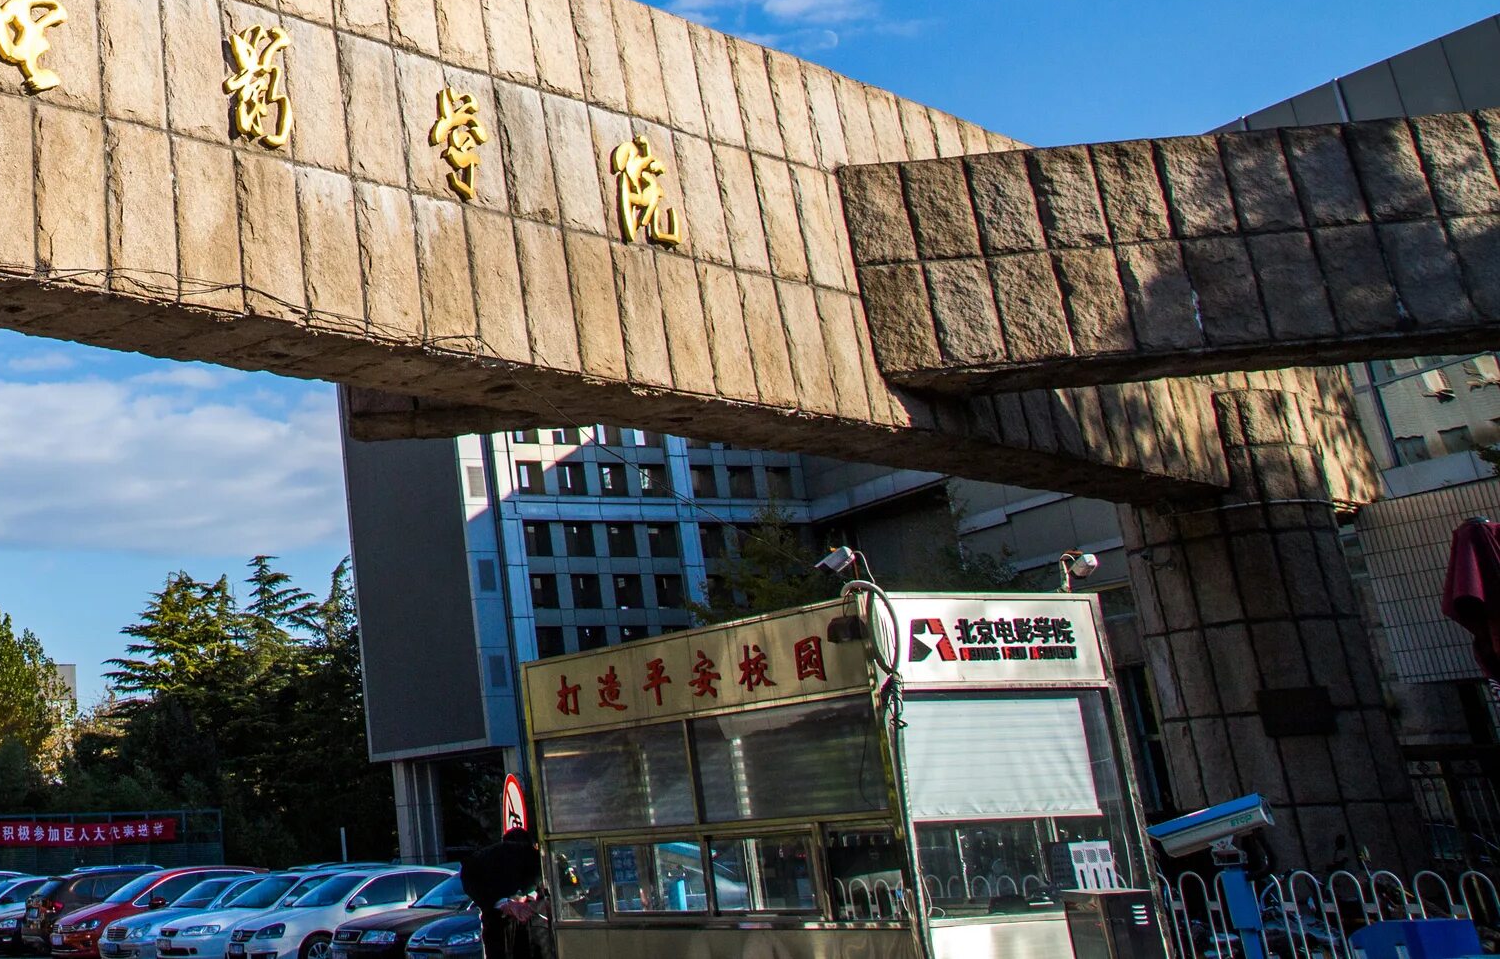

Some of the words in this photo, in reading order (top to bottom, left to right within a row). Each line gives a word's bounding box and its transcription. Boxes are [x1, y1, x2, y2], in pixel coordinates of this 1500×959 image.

[955, 617, 1077, 644] 北京电影学院
[556, 636, 827, 715] 打造平安校园
